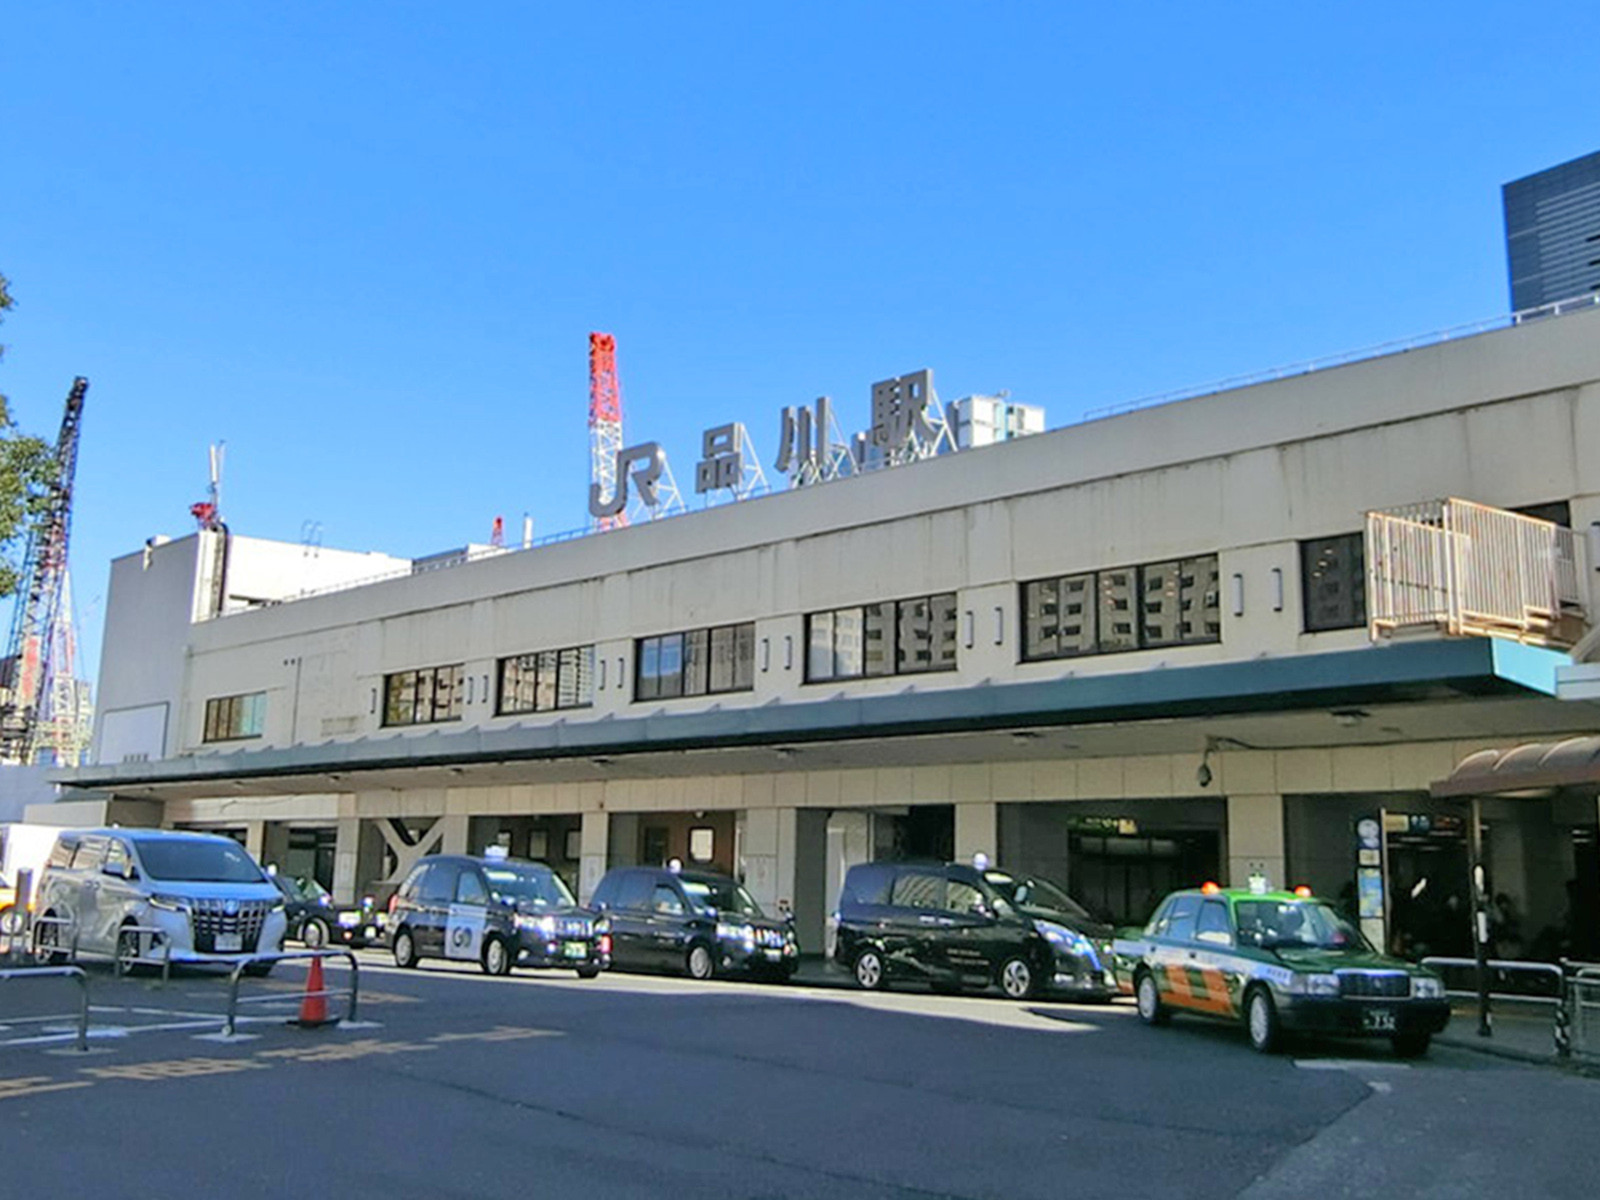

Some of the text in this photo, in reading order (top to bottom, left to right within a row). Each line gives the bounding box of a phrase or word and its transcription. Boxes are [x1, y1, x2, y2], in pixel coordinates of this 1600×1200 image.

[589, 369, 936, 517] JR 品川駅
